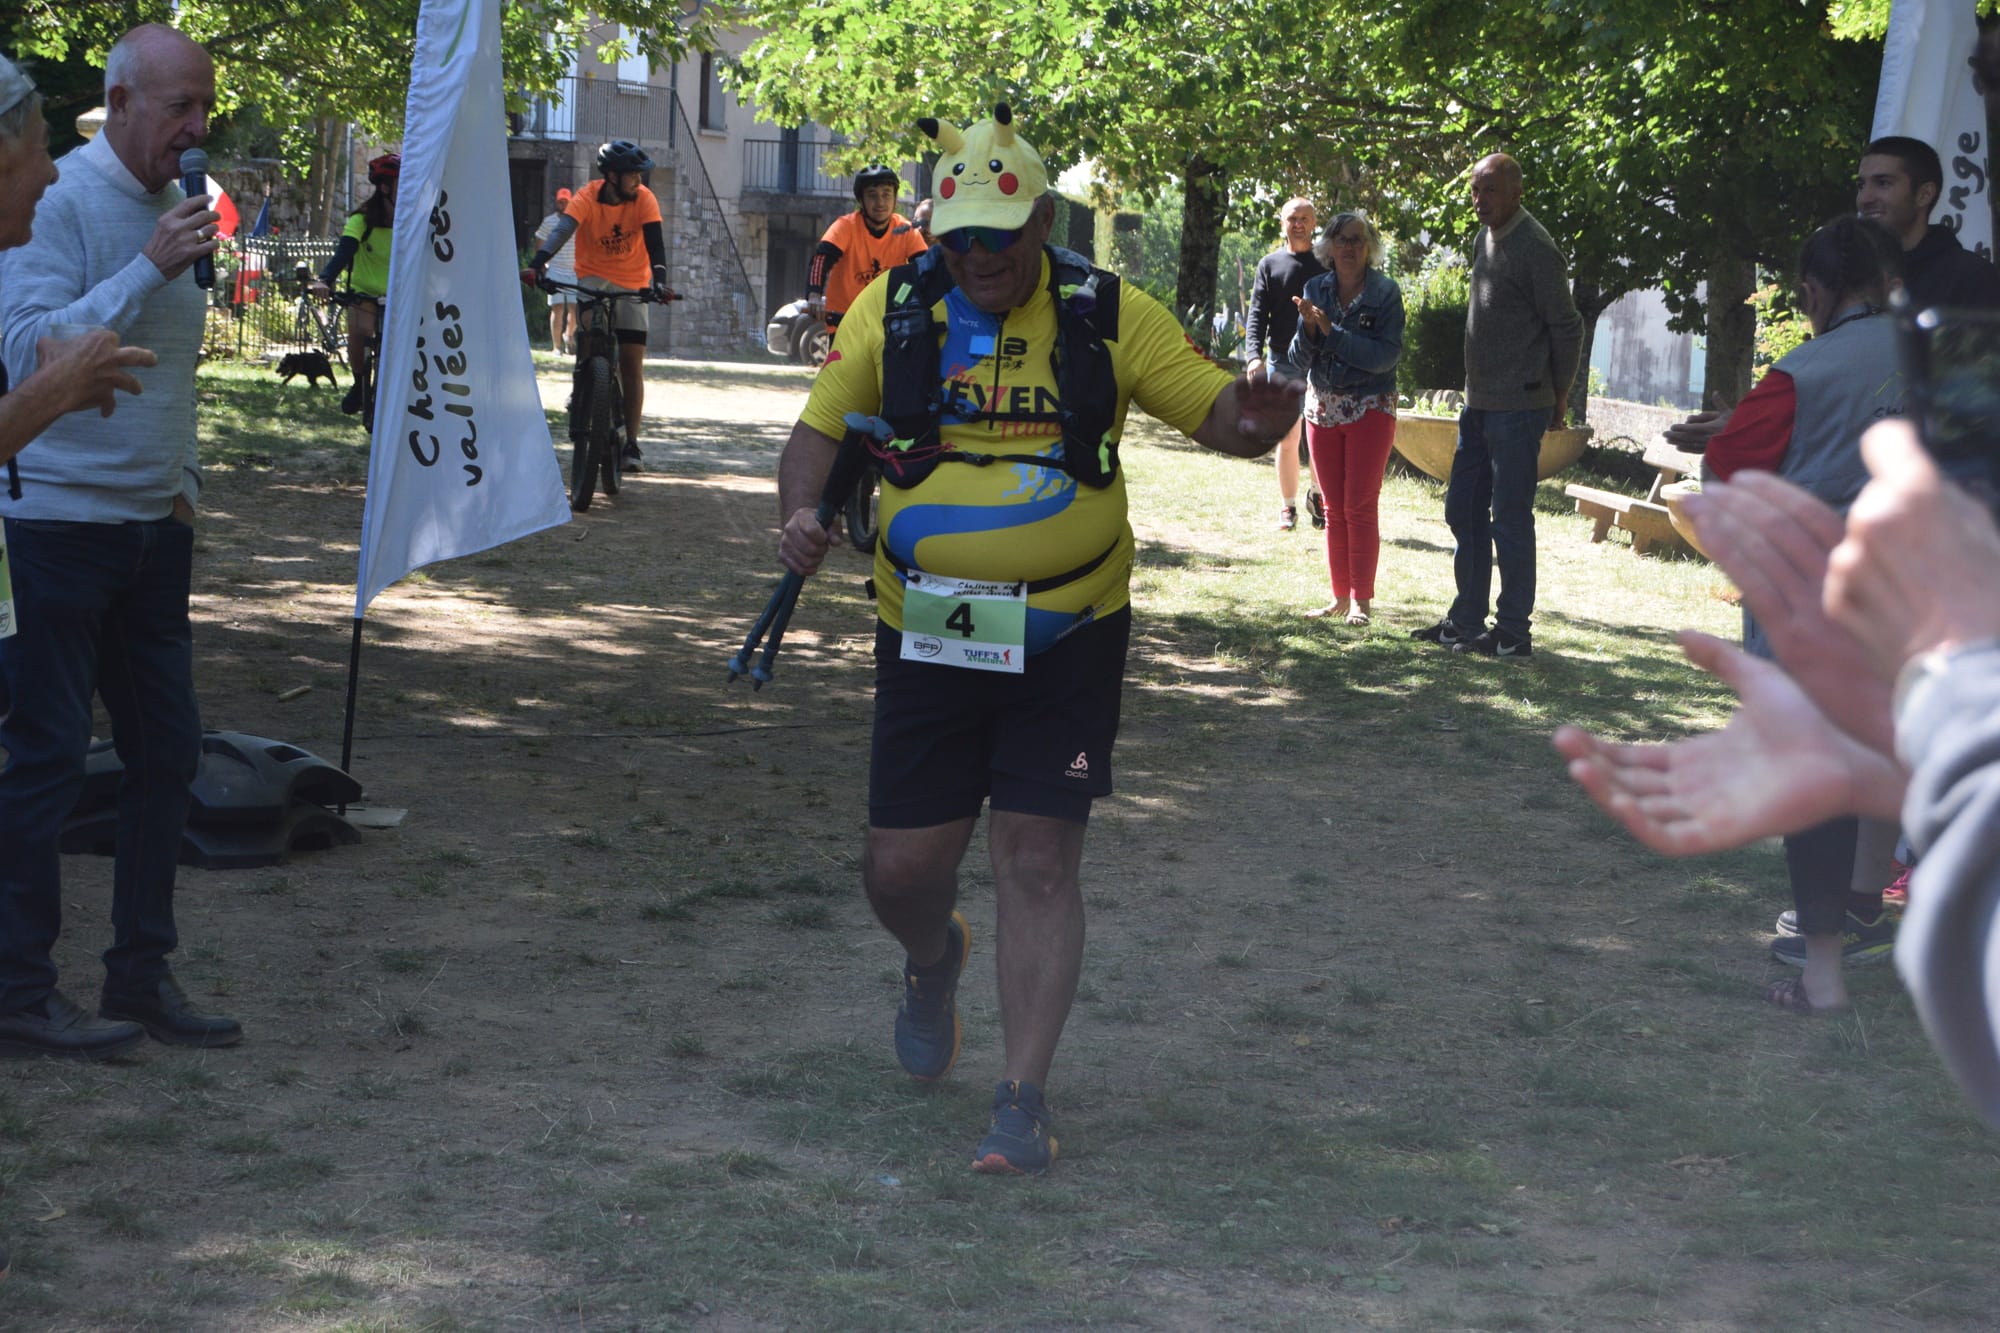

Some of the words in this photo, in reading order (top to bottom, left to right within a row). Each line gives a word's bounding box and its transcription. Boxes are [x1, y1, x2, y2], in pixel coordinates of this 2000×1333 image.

[1940, 131, 1985, 235] enge
[434, 301, 483, 486] vallées
[945, 602, 975, 638] 4
[963, 649, 1000, 659] TUFF'S
